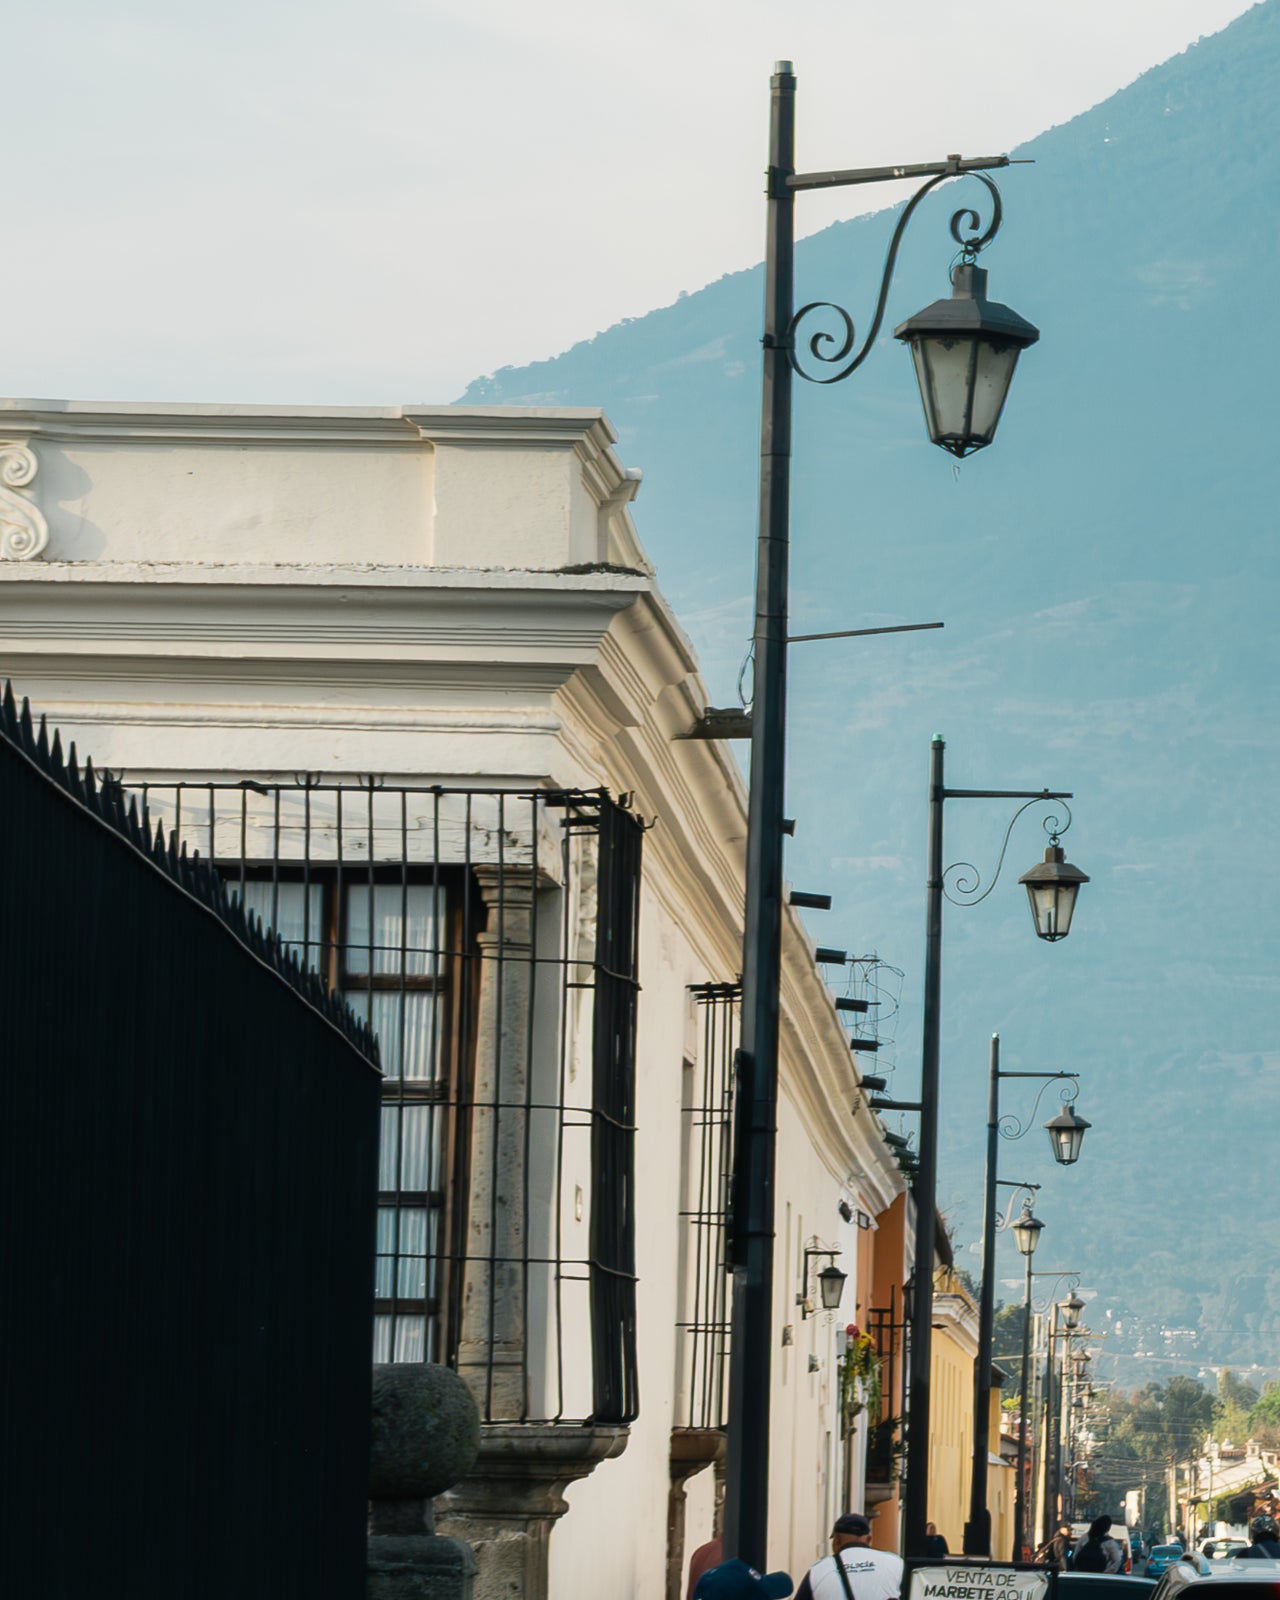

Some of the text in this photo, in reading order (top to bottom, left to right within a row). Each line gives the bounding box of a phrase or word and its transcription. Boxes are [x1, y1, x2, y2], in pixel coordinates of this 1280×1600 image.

[946, 1569, 1016, 1587] VENTA DE
[924, 1584, 995, 1600] MARBETE
